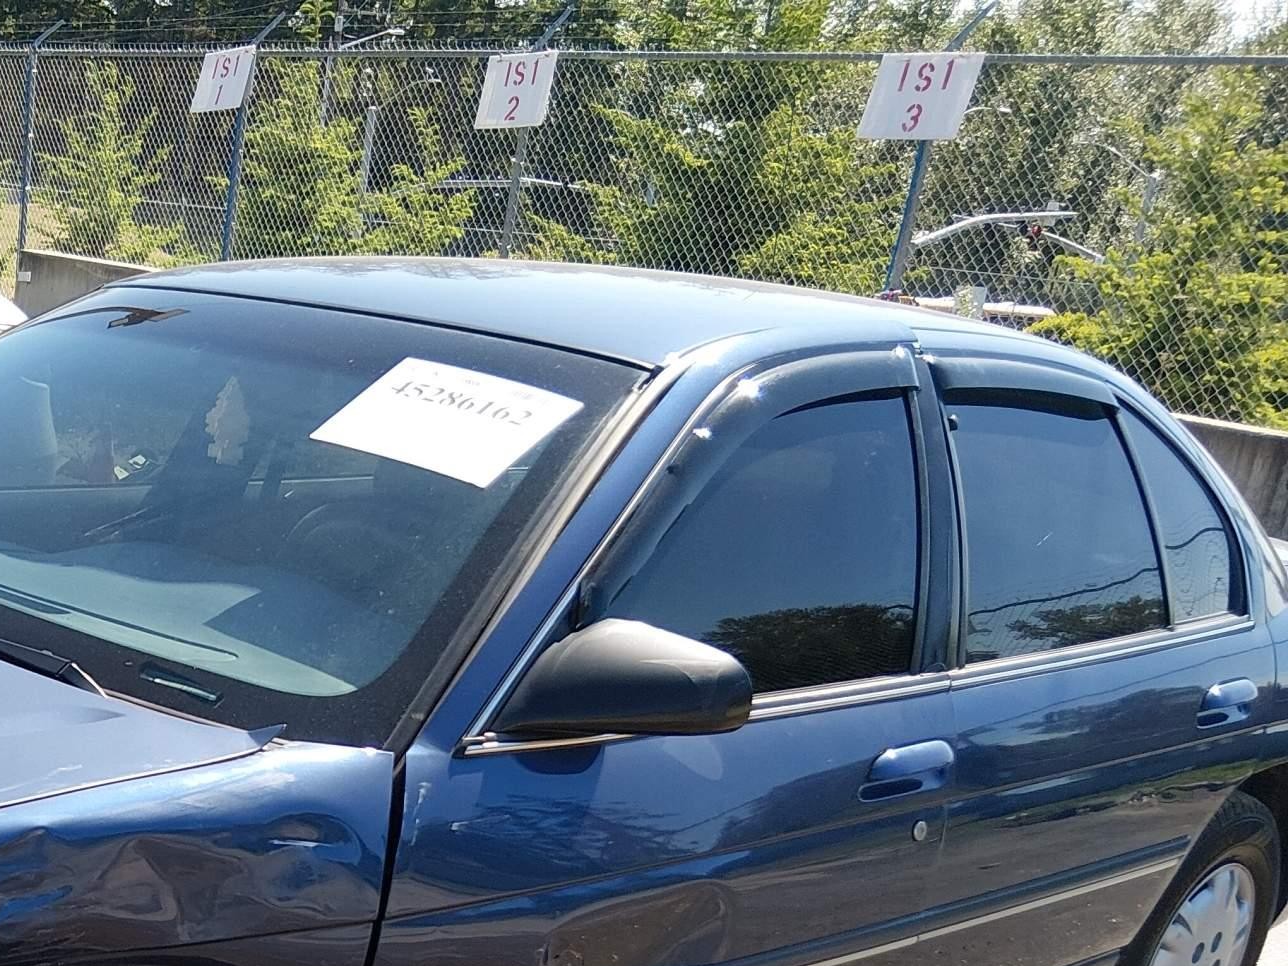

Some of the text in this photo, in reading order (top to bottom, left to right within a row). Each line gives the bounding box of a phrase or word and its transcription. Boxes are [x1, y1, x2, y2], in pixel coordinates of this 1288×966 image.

[504, 95, 520, 121] 2
[901, 103, 923, 132] 3
[391, 381, 533, 425] 45286162
